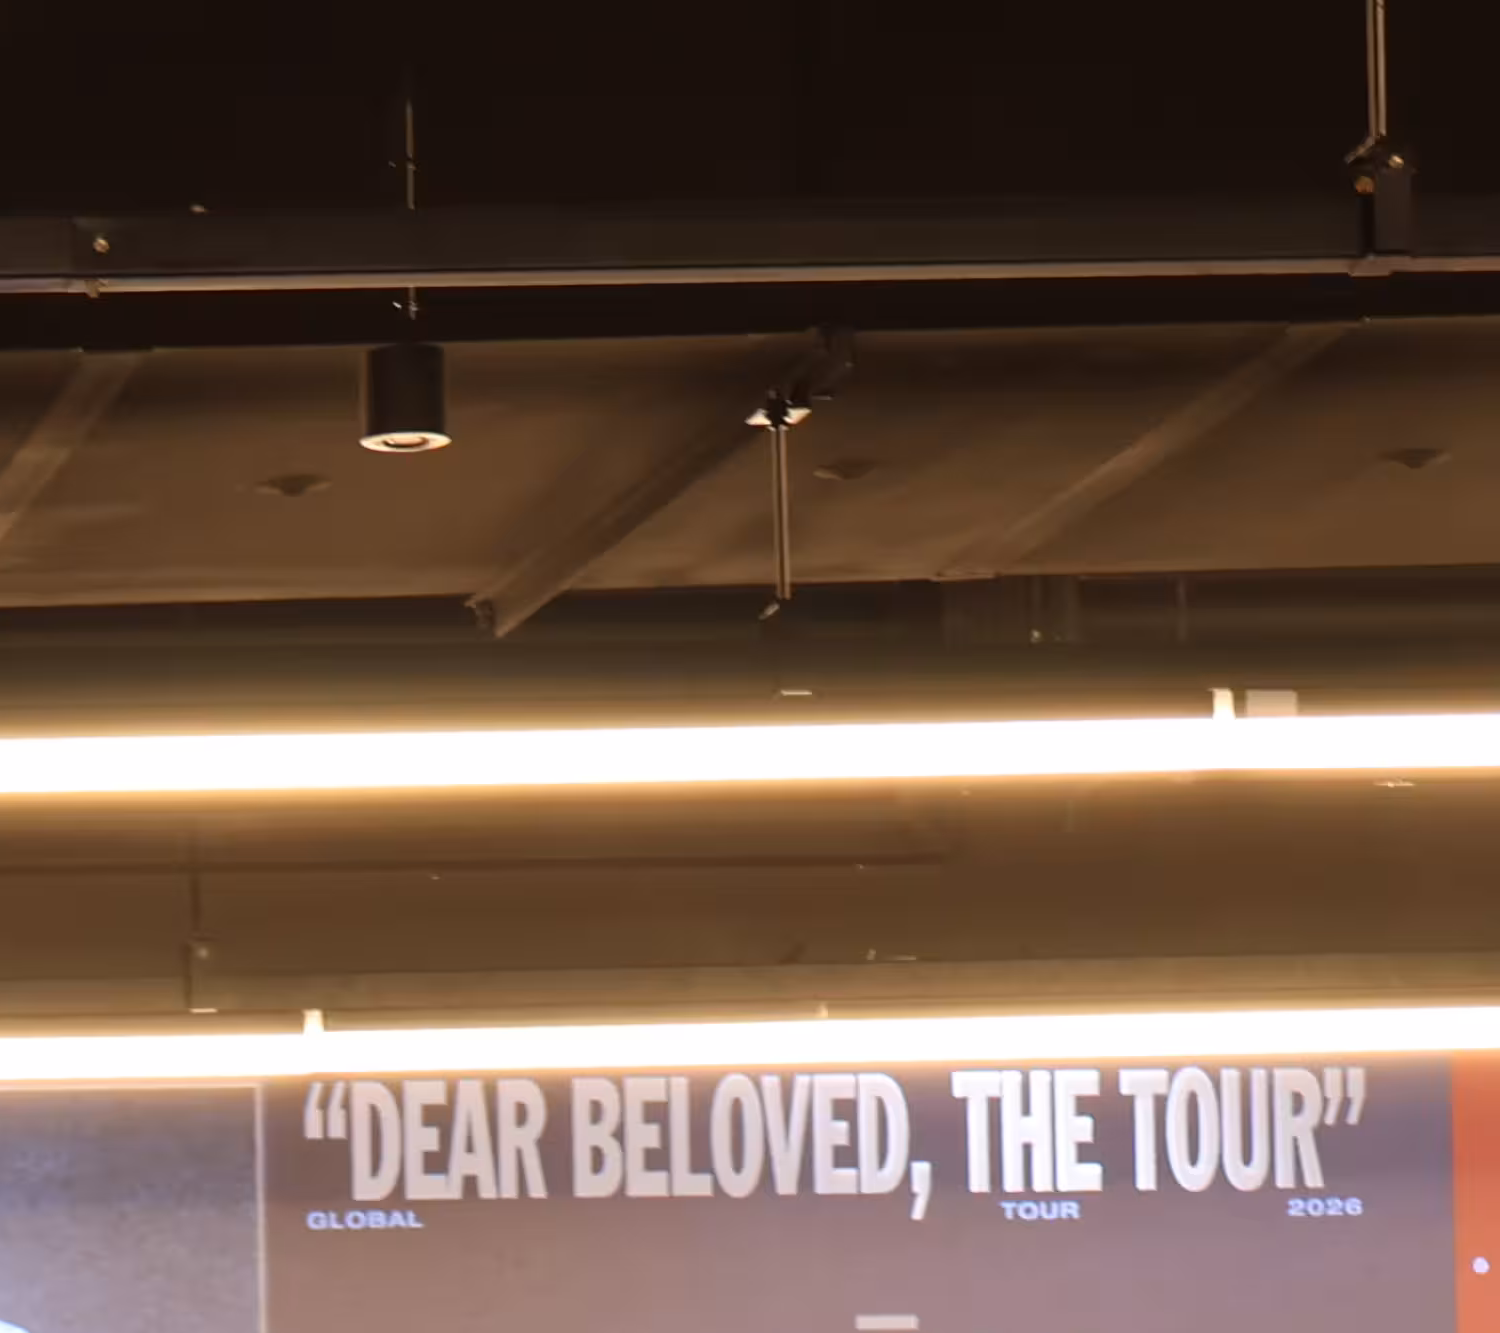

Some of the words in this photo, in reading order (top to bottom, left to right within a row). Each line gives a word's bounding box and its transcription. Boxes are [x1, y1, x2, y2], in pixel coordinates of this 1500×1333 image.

[304, 1079, 547, 1200] “DEAR
[572, 1073, 931, 1220] BELOVED,
[951, 1070, 1102, 1192] THE
[1119, 1067, 1365, 1192] TOUR”
[307, 1212, 423, 1230] GLOBAL
[1001, 1201, 1080, 1219] TOUR
[1288, 1198, 1362, 1217] 2026
